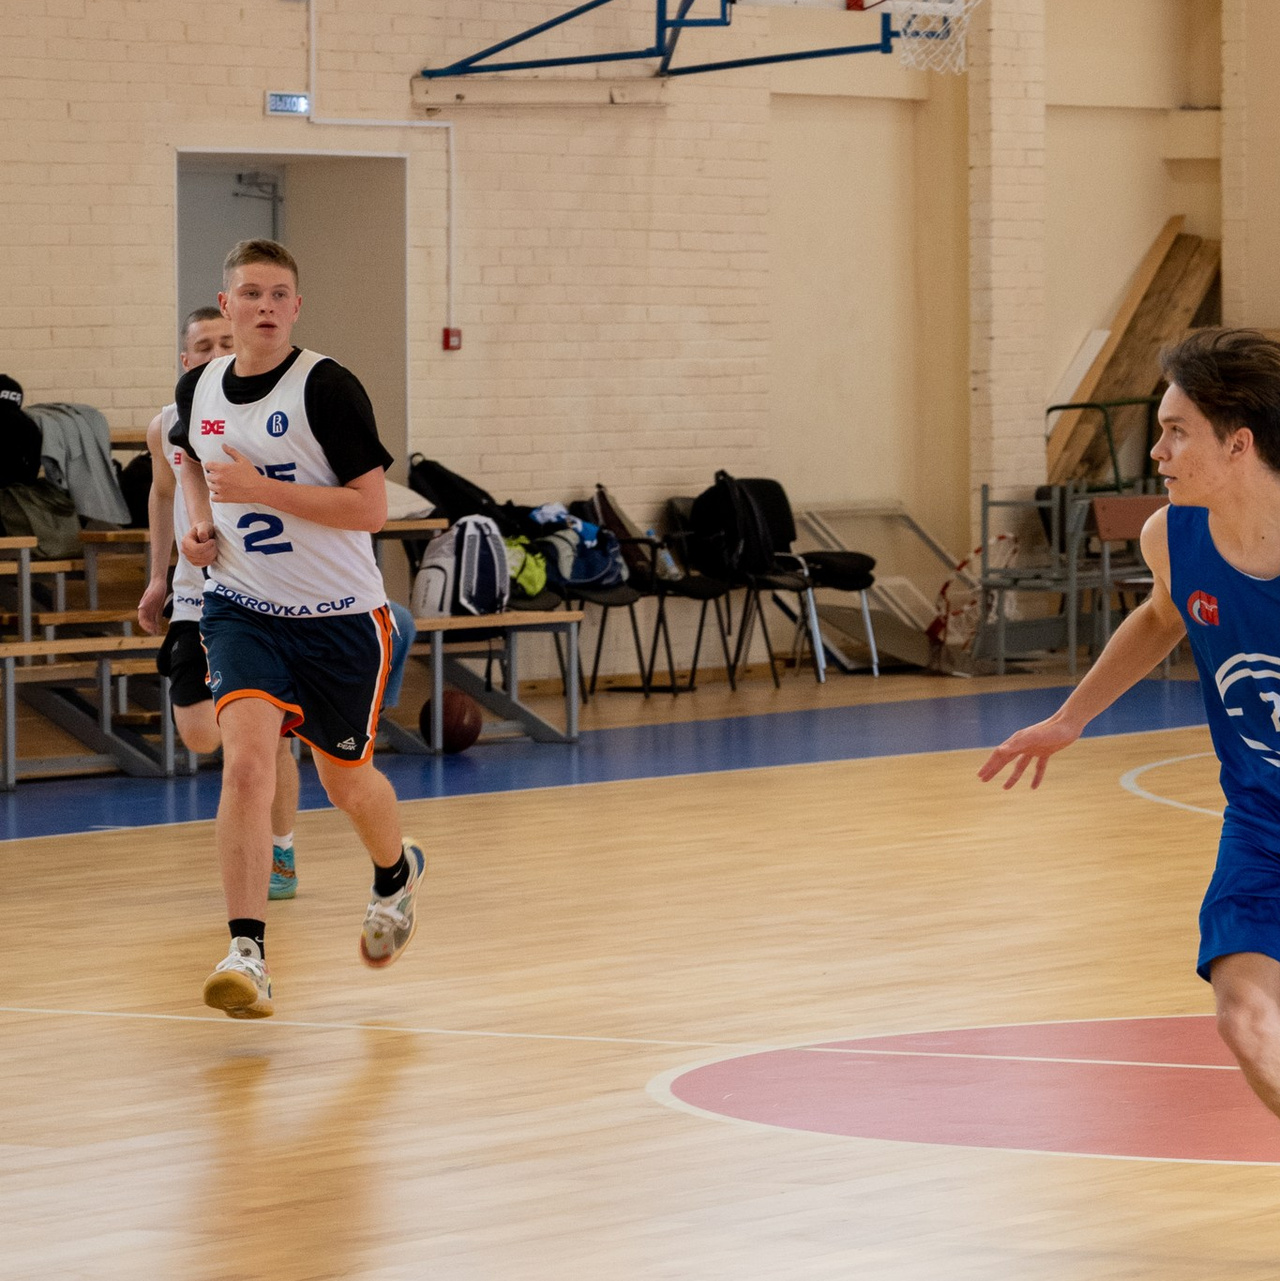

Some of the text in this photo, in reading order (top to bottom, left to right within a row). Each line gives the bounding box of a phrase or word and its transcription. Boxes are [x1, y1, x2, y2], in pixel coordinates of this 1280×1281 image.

[237, 512, 293, 555] 2
[214, 583, 356, 616] POKROVKA CUP
